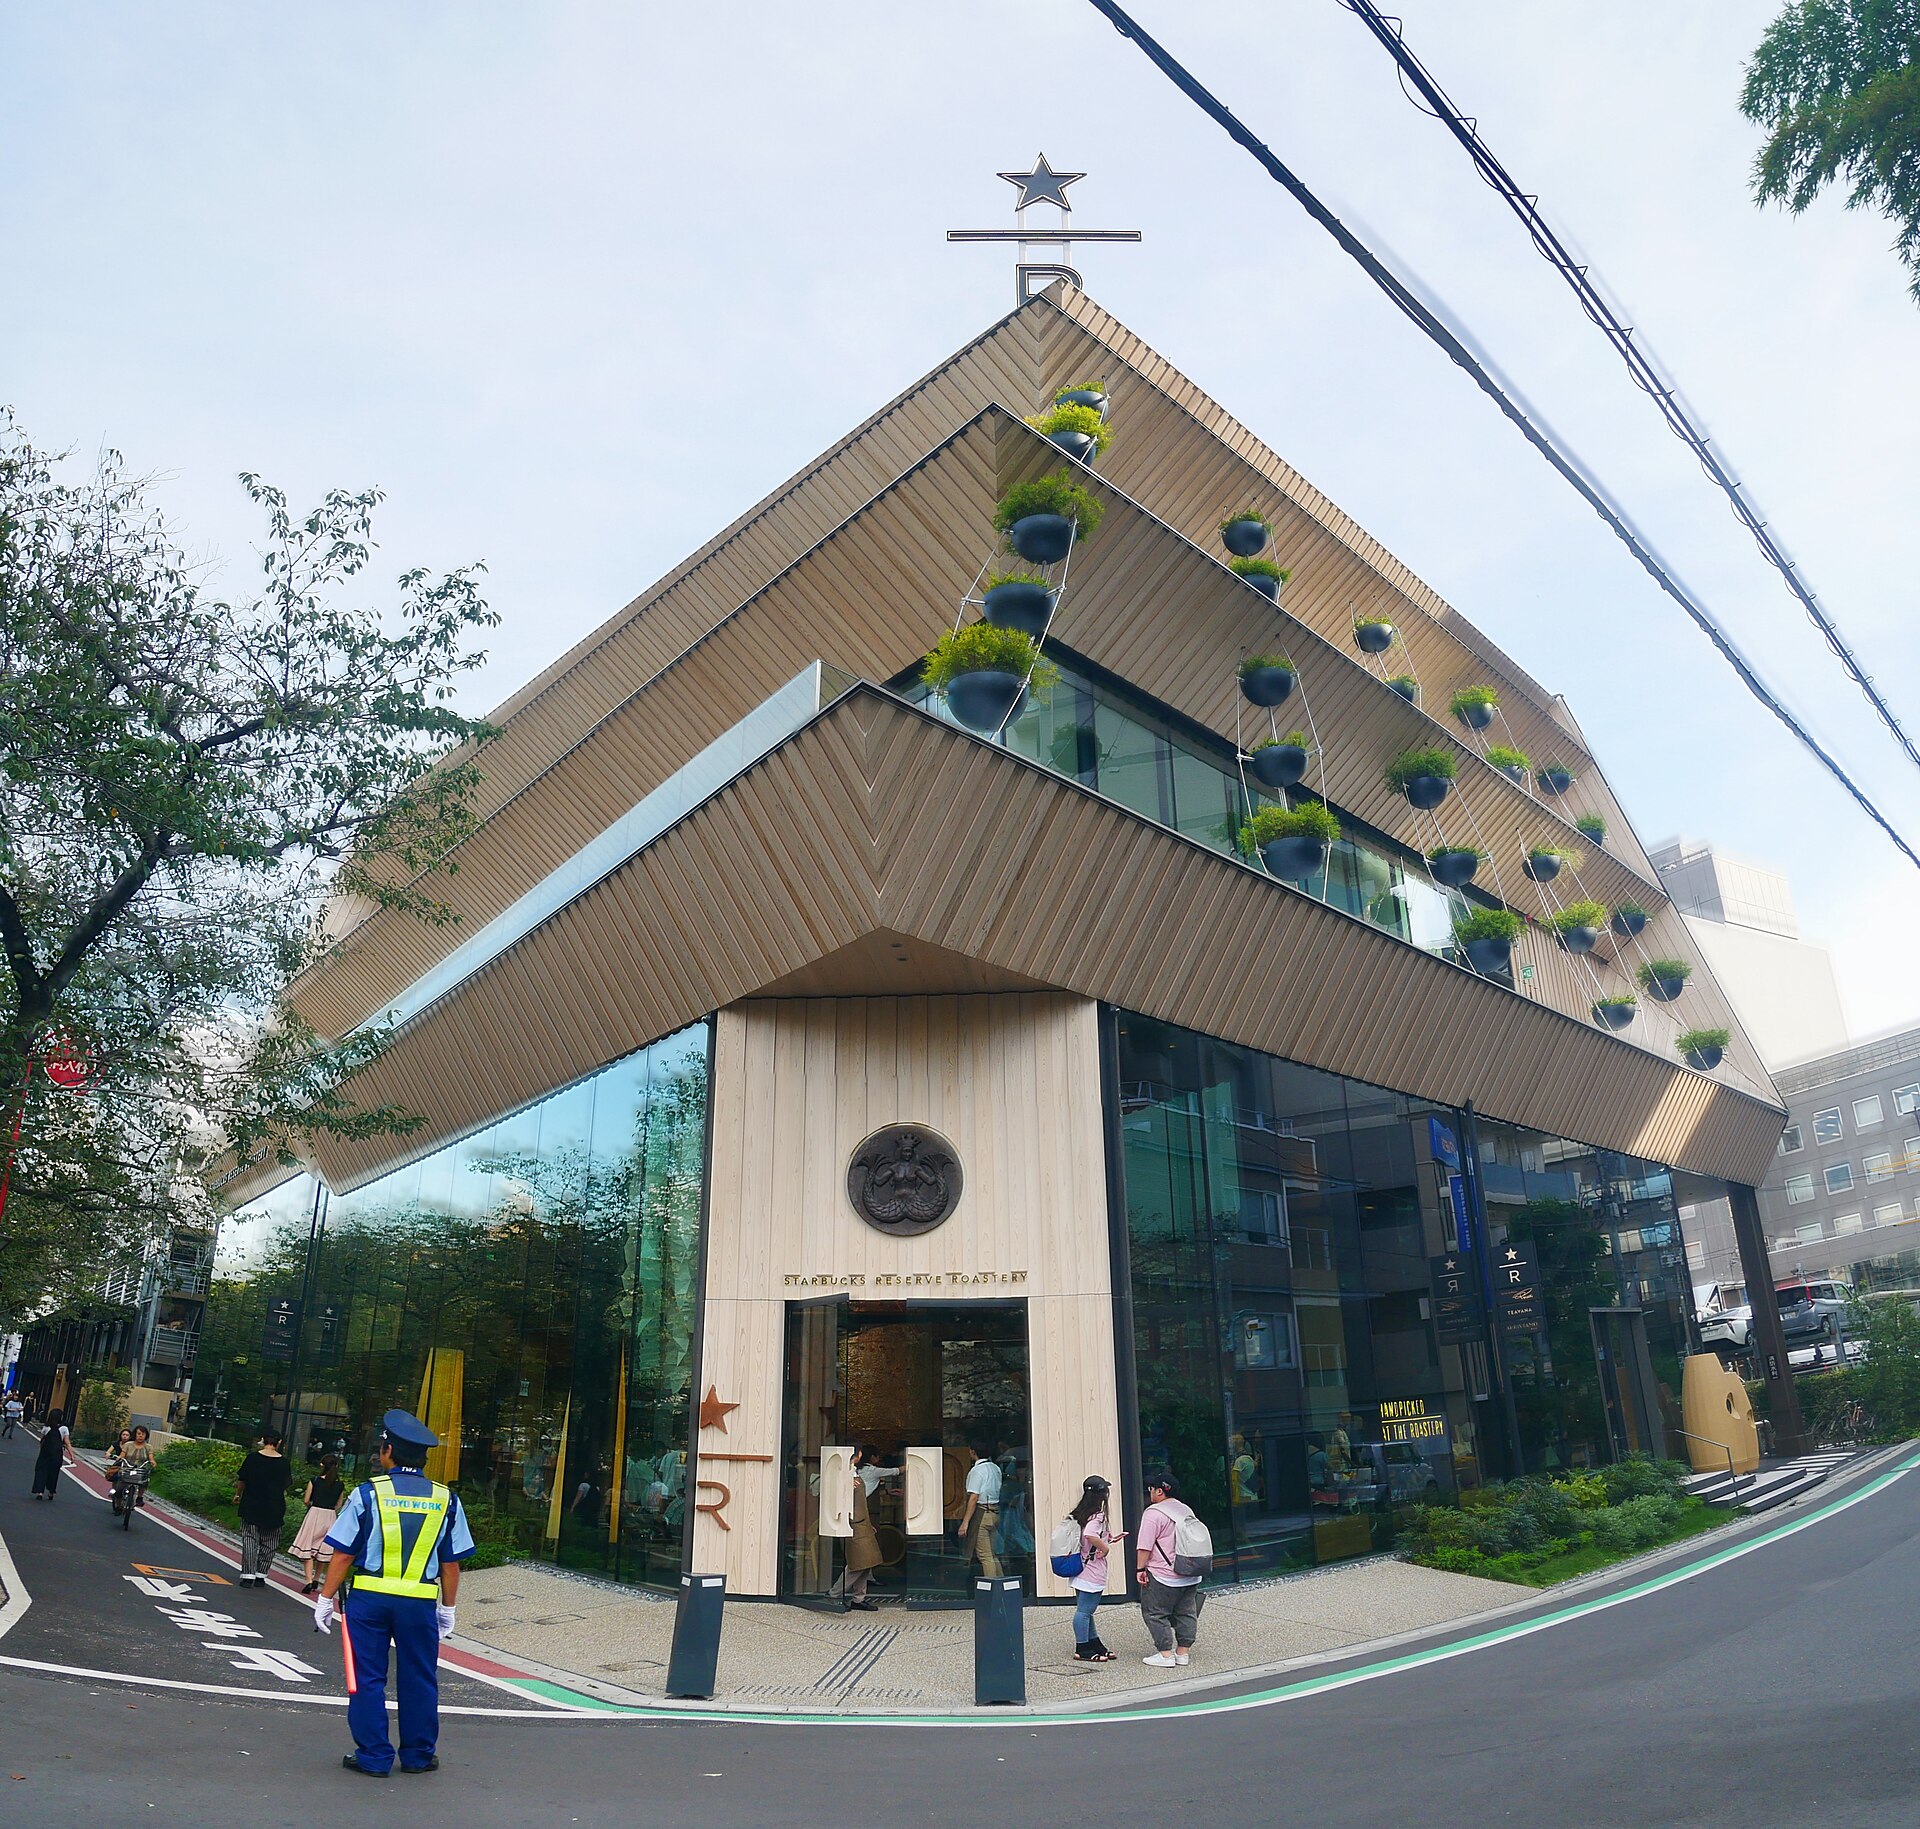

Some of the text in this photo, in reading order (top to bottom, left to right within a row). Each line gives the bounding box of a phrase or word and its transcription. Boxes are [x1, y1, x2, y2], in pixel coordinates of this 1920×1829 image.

[784, 1273, 1028, 1286] STARBUCKS RESERVE ROASTERY
[1508, 1270, 1520, 1283] R
[1507, 1307, 1533, 1316] TEAVANA
[278, 1315, 287, 1325] R
[1393, 1424, 1407, 1440] THE
[1409, 1421, 1443, 1438] ROASTERY
[384, 1498, 442, 1511] TOYO WORK
